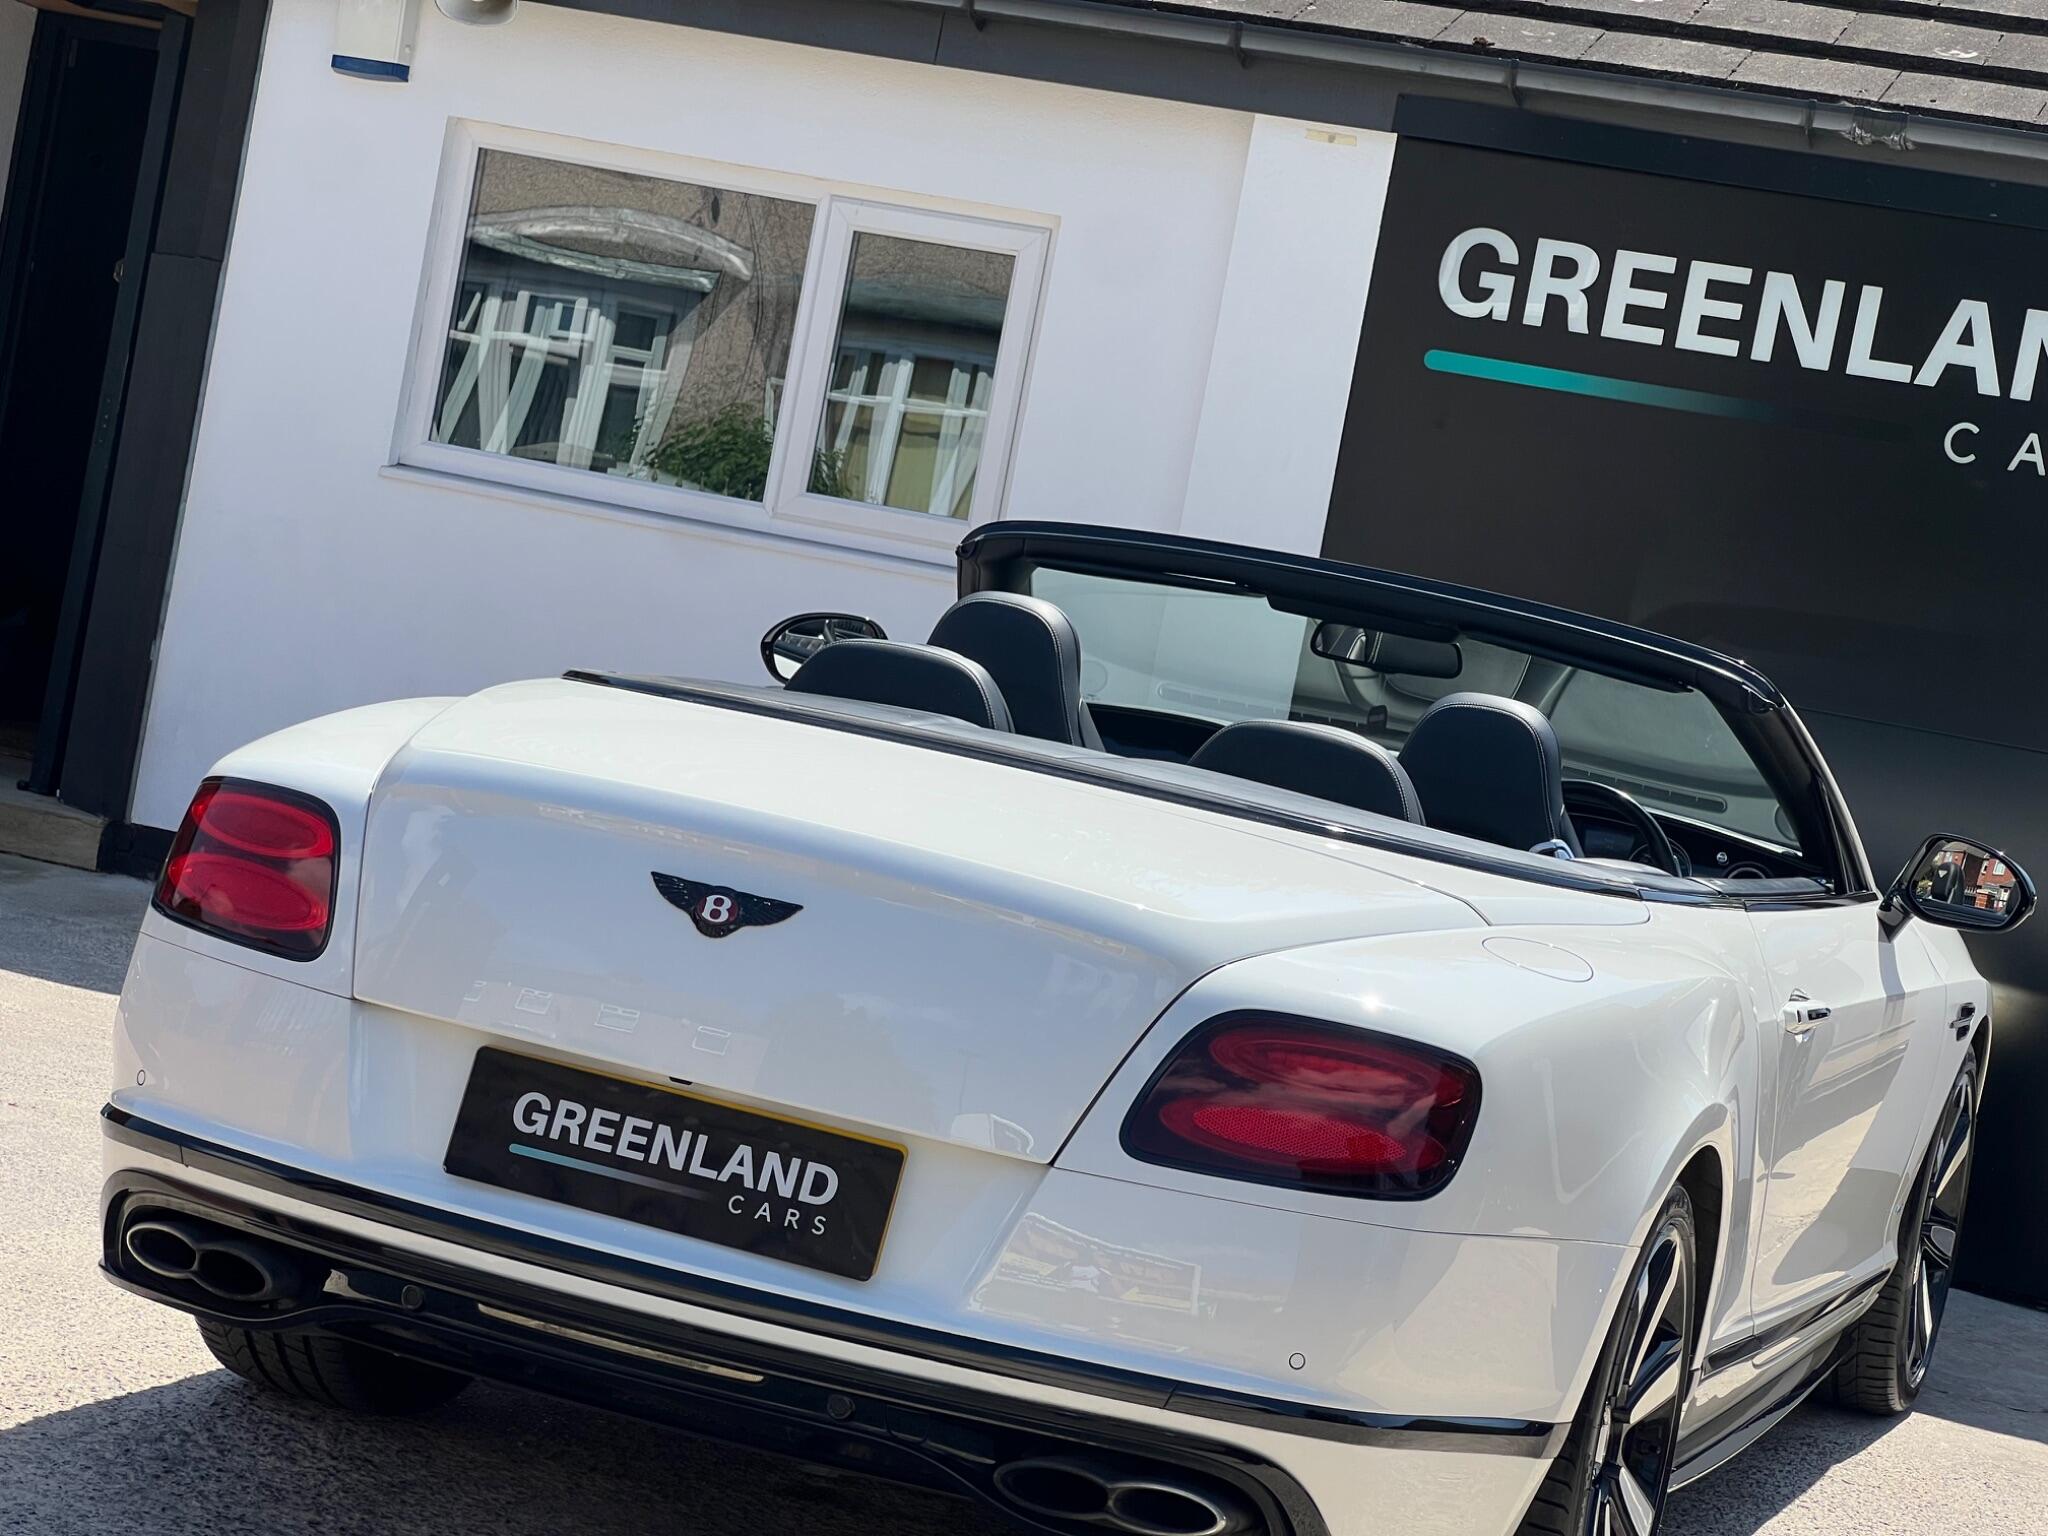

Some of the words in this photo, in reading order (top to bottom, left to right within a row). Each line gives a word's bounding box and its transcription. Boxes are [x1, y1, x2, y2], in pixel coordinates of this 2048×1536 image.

[1943, 421, 2047, 476] CA
[701, 894, 732, 923] B
[512, 1091, 839, 1205] GREENLAND
[727, 1194, 828, 1236] CARS
